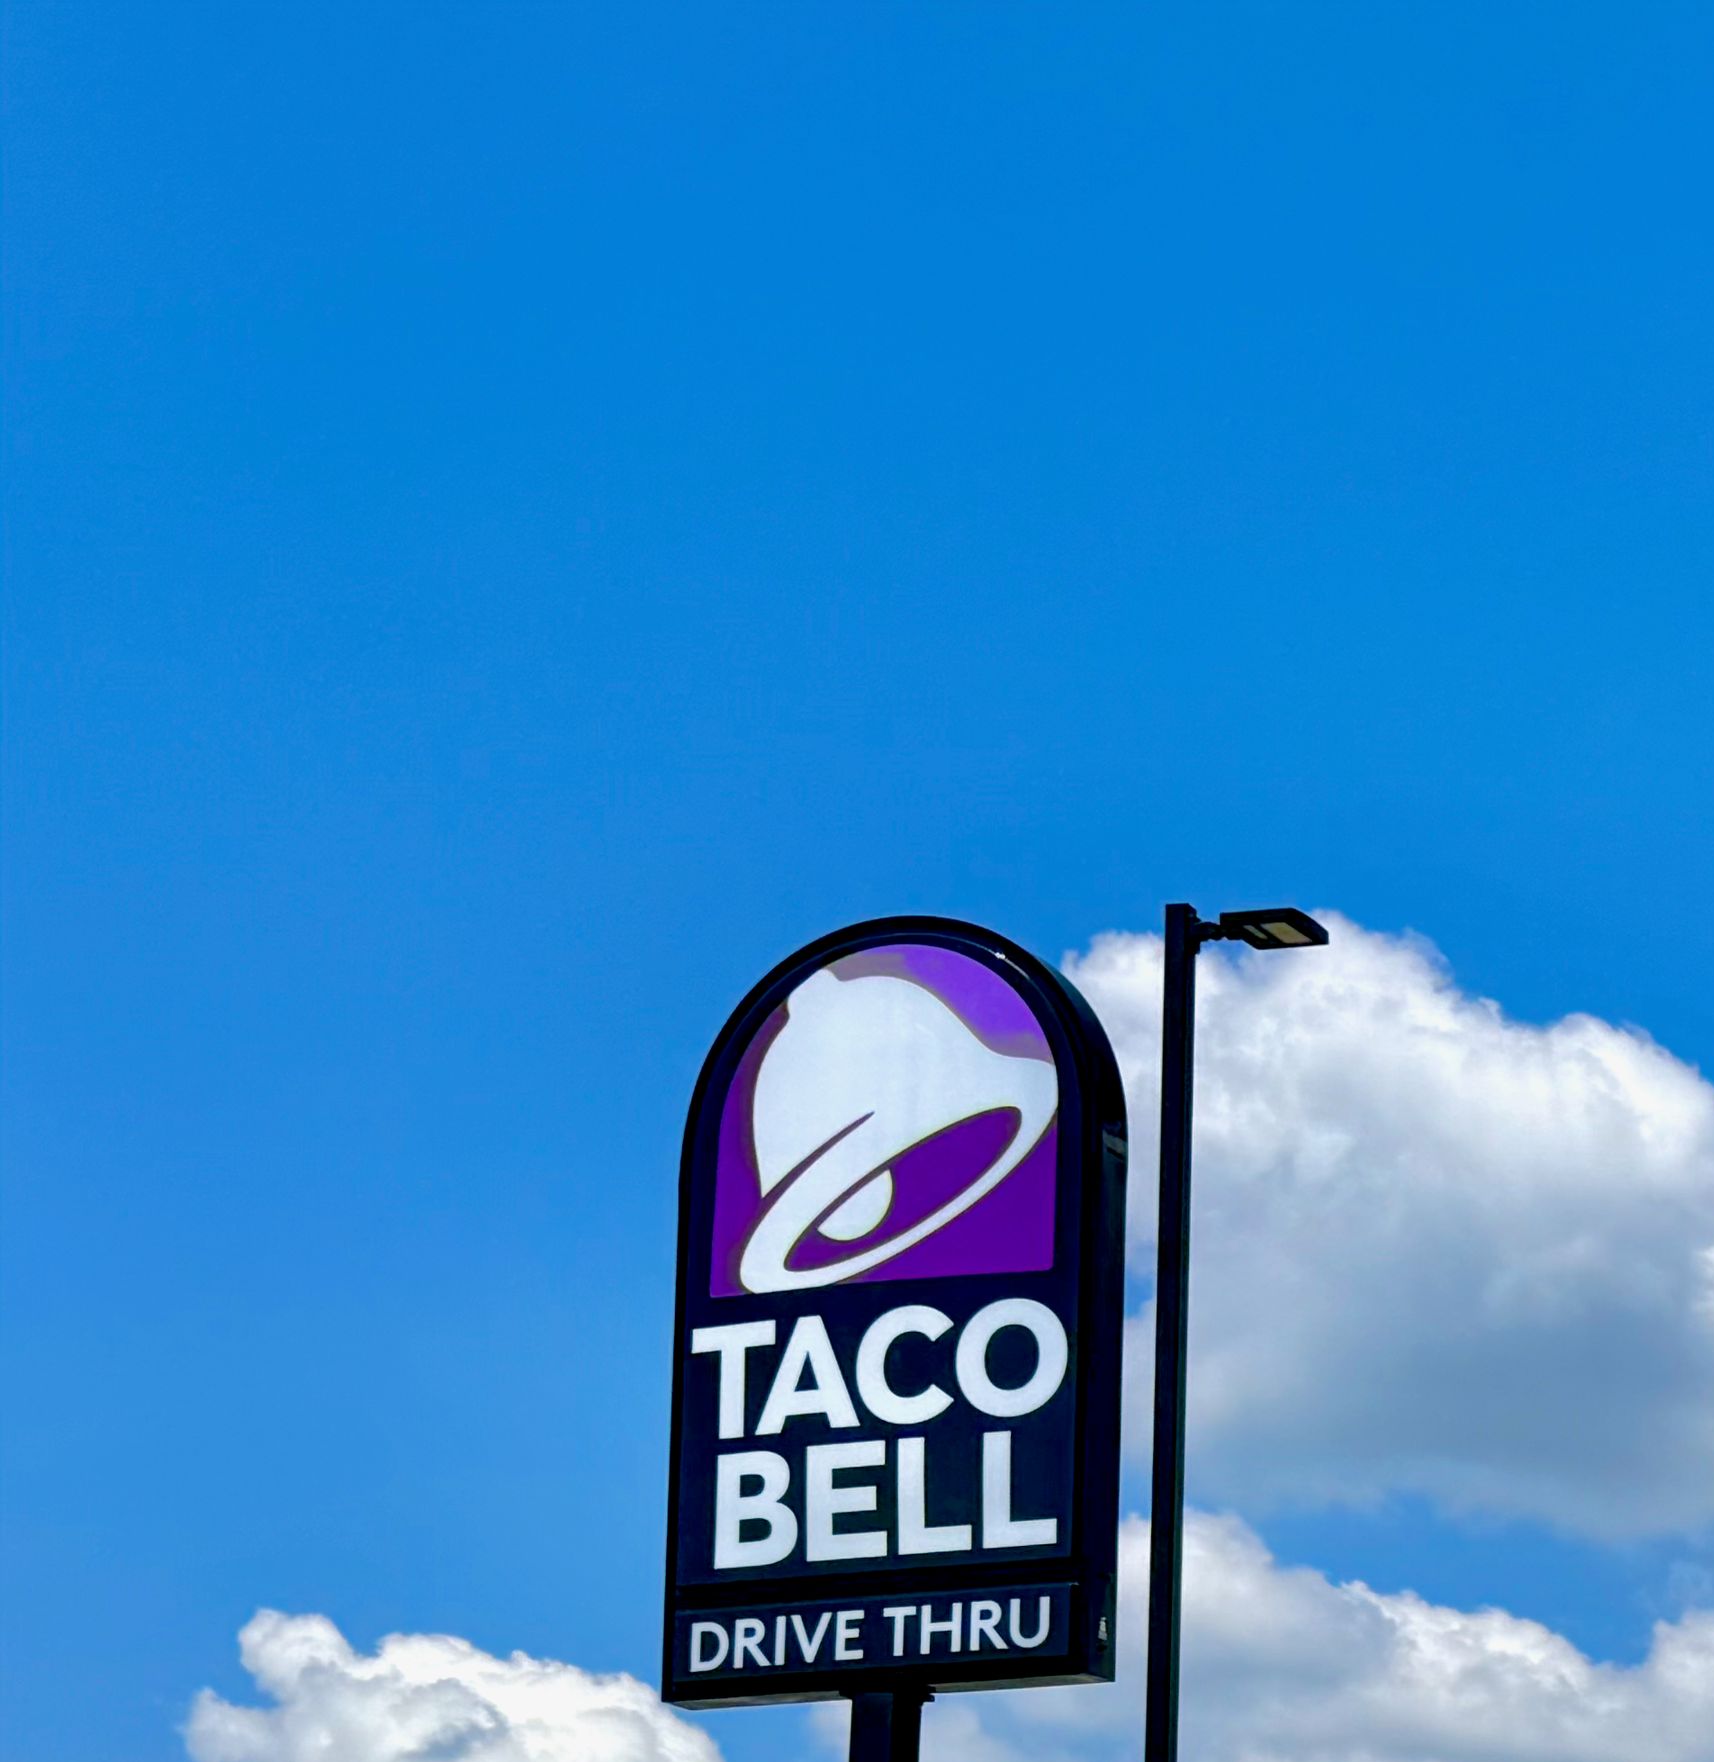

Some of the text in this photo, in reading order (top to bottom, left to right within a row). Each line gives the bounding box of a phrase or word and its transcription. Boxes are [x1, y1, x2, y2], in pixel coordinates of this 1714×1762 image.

[690, 1298, 1069, 1440] TACO
[713, 1430, 1058, 1570] BELL
[689, 1595, 1051, 1674] DRIVE THRU
